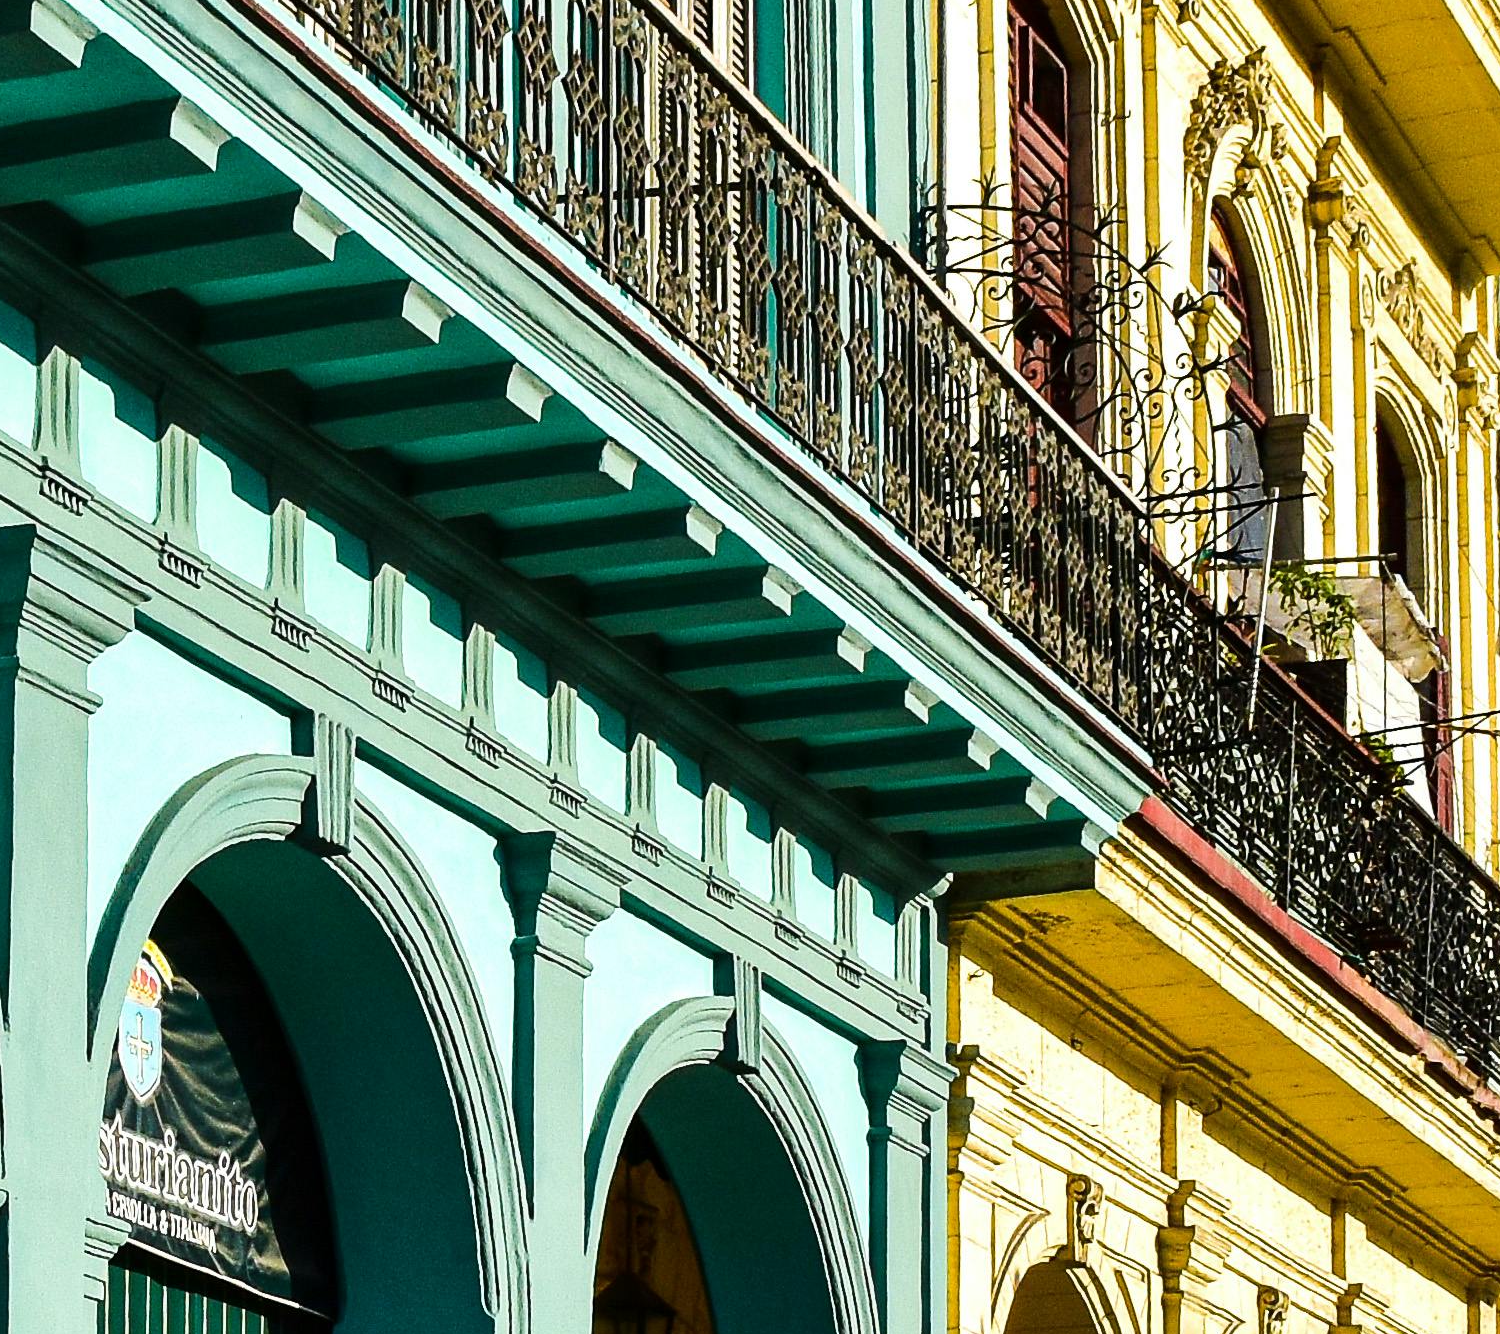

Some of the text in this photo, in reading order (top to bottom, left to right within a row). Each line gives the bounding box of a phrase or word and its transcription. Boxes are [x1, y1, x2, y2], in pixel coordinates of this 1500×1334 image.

[99, 1109, 259, 1236] sturianito
[112, 1191, 158, 1232] CRIOLLA
[159, 1209, 168, 1236] &
